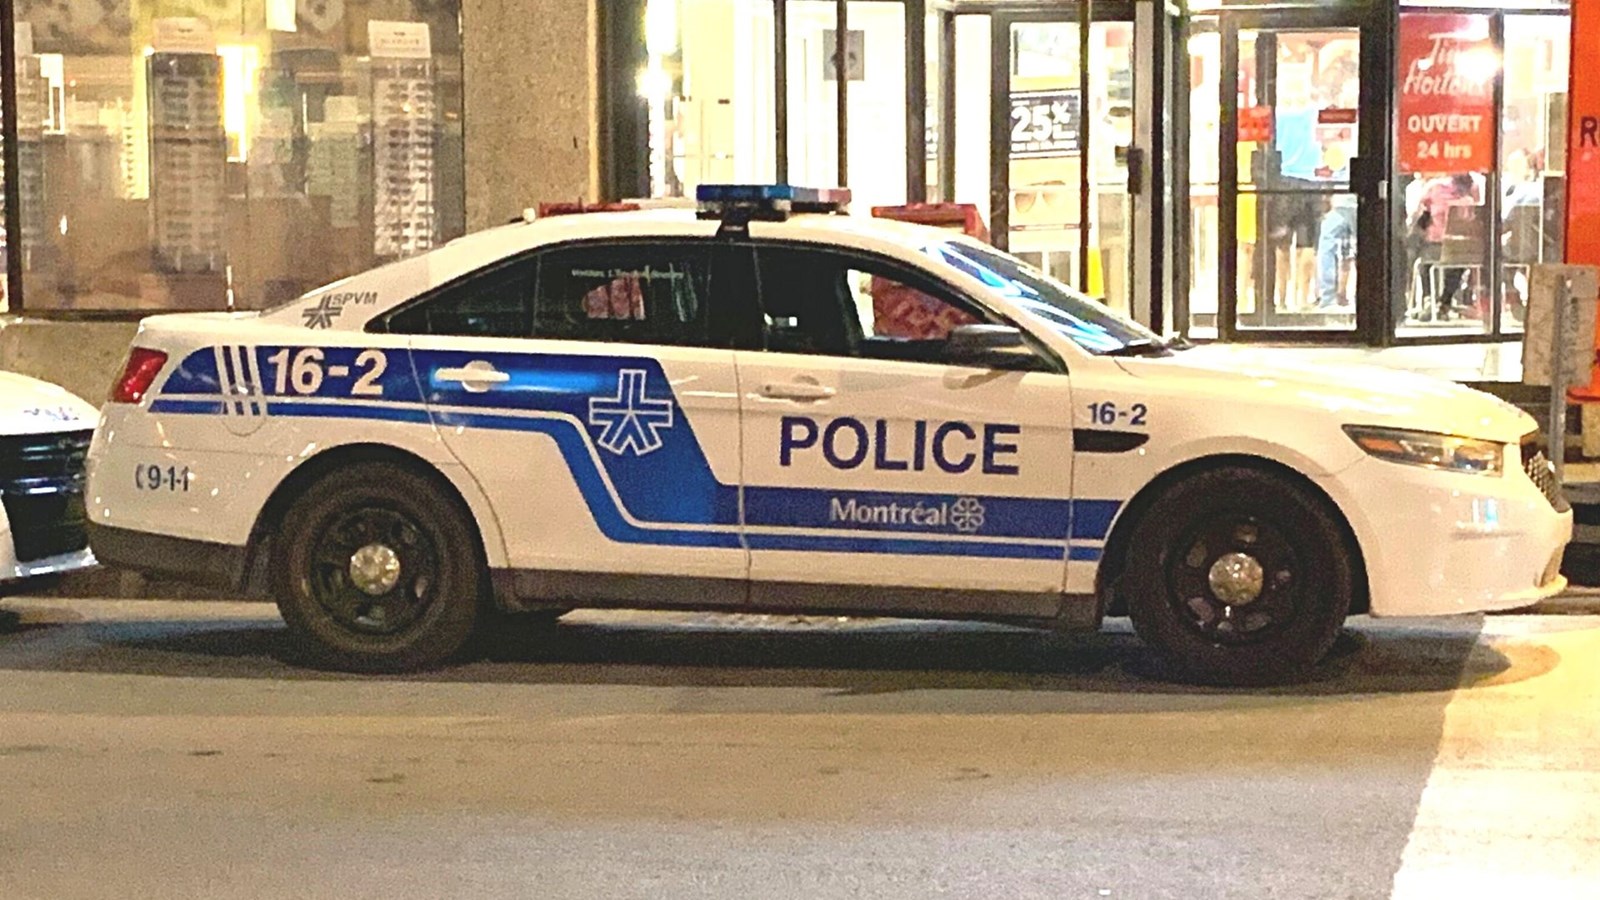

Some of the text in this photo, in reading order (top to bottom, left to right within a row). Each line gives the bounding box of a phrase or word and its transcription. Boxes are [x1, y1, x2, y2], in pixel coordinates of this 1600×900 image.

[1407, 114, 1482, 133] OUVERT
[1417, 139, 1471, 158] 24 hrs
[331, 291, 377, 305] SPVM
[267, 347, 387, 395] 16-2
[1087, 401, 1147, 425] 16-2
[780, 416, 1020, 475] POLICE
[830, 497, 947, 526] Montréal
